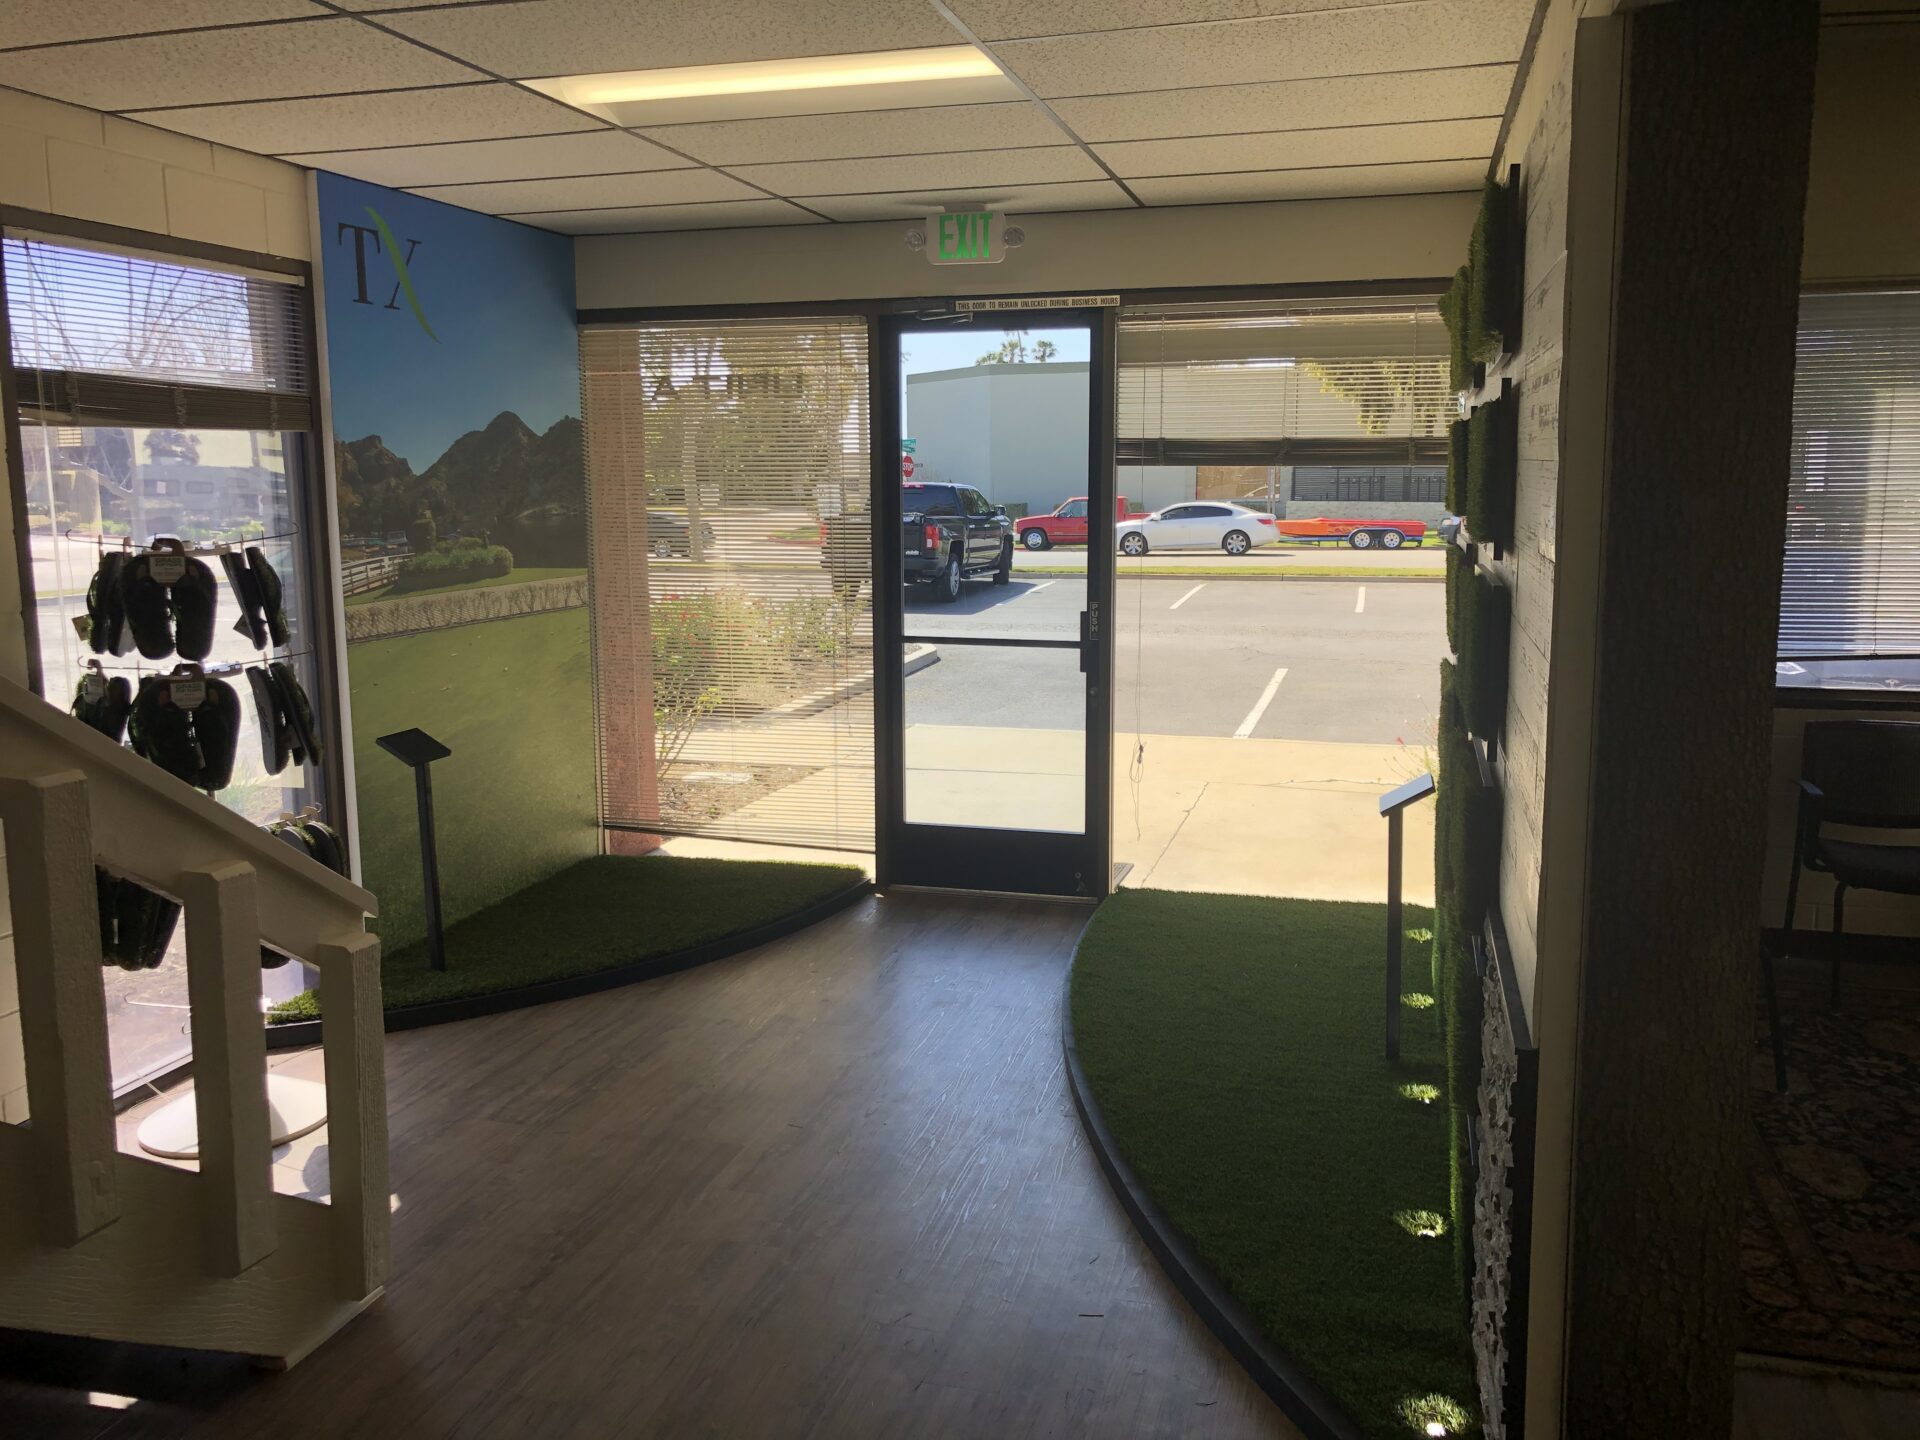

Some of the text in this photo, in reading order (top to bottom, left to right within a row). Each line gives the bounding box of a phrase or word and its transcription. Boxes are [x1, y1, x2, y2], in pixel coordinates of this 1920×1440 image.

[938, 212, 993, 260] EXIT
[958, 296, 1119, 310] THIS DOOR TO REMAIN UNLOCKED DURING BUSINESS HOURS
[1091, 603, 1099, 632] PUSH
